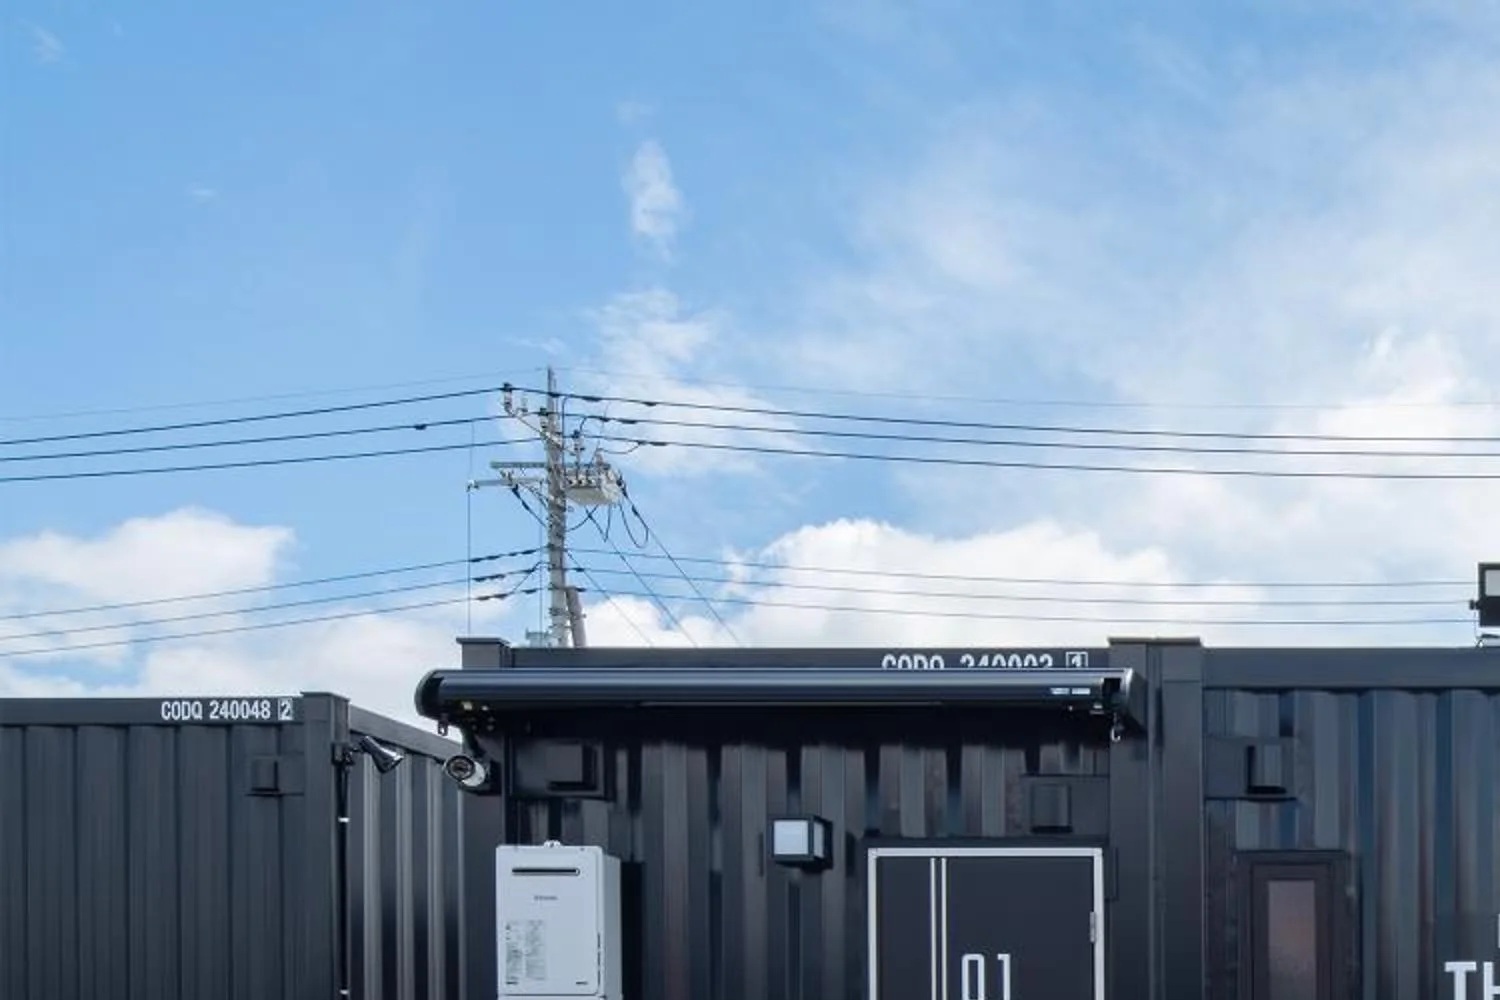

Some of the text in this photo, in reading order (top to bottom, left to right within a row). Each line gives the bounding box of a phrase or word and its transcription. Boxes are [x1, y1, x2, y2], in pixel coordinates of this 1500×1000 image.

[161, 699, 293, 720] CODQ 240048 2
